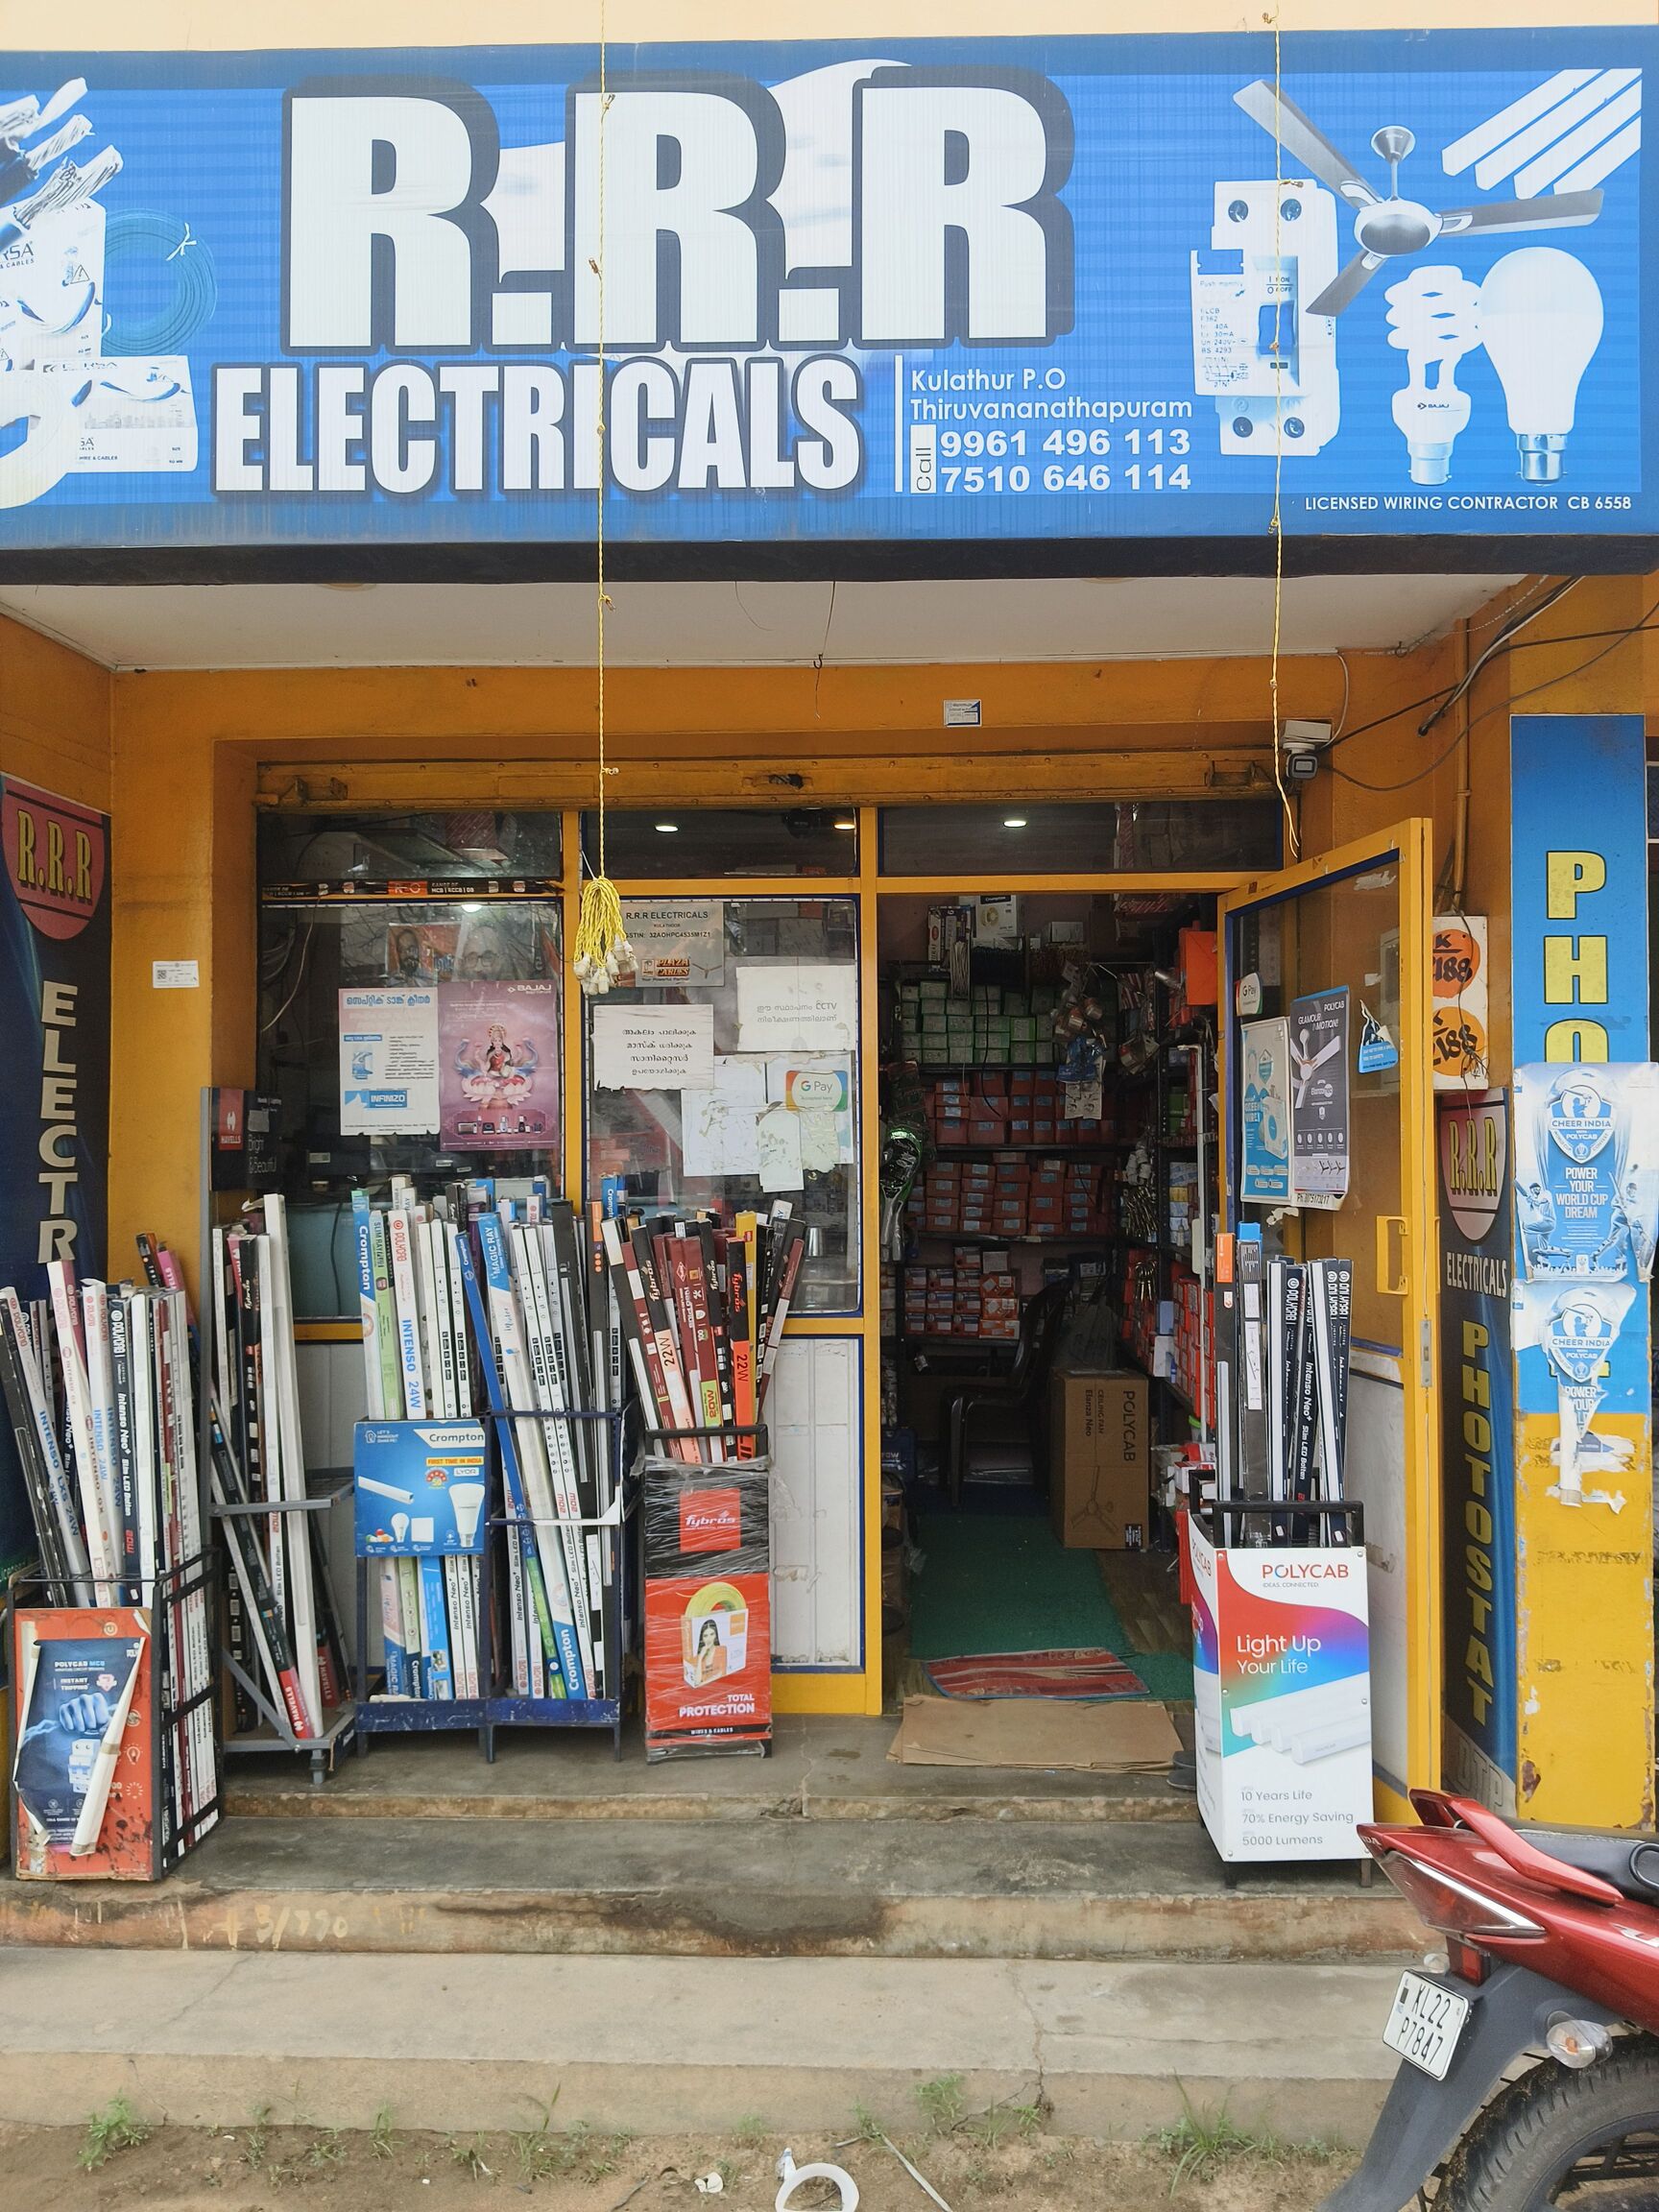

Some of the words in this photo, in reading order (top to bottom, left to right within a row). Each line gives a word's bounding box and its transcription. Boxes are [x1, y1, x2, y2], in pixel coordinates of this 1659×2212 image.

[289, 87, 1047, 349] R.R.R
[911, 368, 1015, 392] Kulathur
[1022, 367, 1067, 391] P.O
[910, 397, 1192, 423] Thiruvananathapuram
[215, 358, 861, 494] ELECTRICALS
[940, 429, 1027, 456] 9961
[1043, 428, 1112, 455] 496
[1123, 427, 1191, 455] 113
[916, 446, 933, 492] Call
[940, 467, 1030, 493] 7510
[1043, 465, 1112, 492] 646
[1123, 465, 1192, 491] 114
[1305, 497, 1379, 511] LICENSED
[1383, 496, 1443, 510] WIRING
[1447, 495, 1559, 510] CONTRACTOR
[1567, 495, 1591, 510] CB
[1594, 495, 1632, 509] 6558
[651, 911, 709, 920] ELECTRICALS
[1323, 999, 1345, 1012] POLYCAB
[813, 1081, 833, 1093] Pay
[1551, 1119, 1582, 1128] CHEER
[1584, 1119, 1612, 1128] INDIA
[1565, 1167, 1598, 1179] POWER
[1570, 1181, 1595, 1192] YOUR
[1555, 1193, 1588, 1206] WORLD
[1590, 1193, 1609, 1206] CUP
[1565, 1206, 1598, 1219] DREAM
[373, 1221, 382, 1238] SLIM
[485, 1227, 495, 1244] RAY
[358, 1225, 373, 1290] Crompton
[395, 1232, 407, 1262] POLYCAB
[1446, 1251, 1507, 1299] ELECTRICALS
[1286, 1288, 1298, 1321] POLYCAB
[111, 1321, 125, 1355] POLYCAB
[401, 1319, 417, 1372] INTENSO
[659, 1336, 676, 1367] 22W
[1551, 1337, 1584, 1346] CHEER
[1585, 1338, 1611, 1348] INDIA
[736, 1354, 749, 1382] 22W
[1304, 1361, 1314, 1395] Intenso
[407, 1381, 421, 1409] 24W
[706, 1388, 717, 1419] 20W
[117, 1393, 129, 1429] Intenso
[93, 1409, 105, 1452] INTENSO
[429, 1433, 484, 1443] Crompton
[1085, 1418, 1094, 1436] Neo
[1123, 1390, 1137, 1462] POLYCAB
[39, 1410, 60, 1469] INTENSO
[64, 1504, 81, 1537] 24W
[1459, 1318, 1494, 1727] PHOTOSTAT
[1262, 1563, 1350, 1579] POLYCAB
[451, 1600, 460, 1630] Intenso
[463, 1599, 472, 1630] Intenso
[515, 1592, 523, 1622] Intenso
[576, 1599, 586, 1629] Intenso
[1237, 1634, 1287, 1654] Light
[1292, 1634, 1321, 1657] Up
[559, 1628, 580, 1692] Crompton
[1237, 1659, 1277, 1674] Your
[1280, 1659, 1309, 1674] Life
[320, 1667, 332, 1700] HAVELLS
[284, 1686, 300, 1720] HAVELLS
[679, 1702, 756, 1718] PROTECTION
[727, 1694, 755, 1702] TOTAL
[1240, 1791, 1254, 1801] 10
[1256, 1790, 1290, 1801] Years
[1292, 1790, 1313, 1801] Life
[1242, 1812, 1265, 1824] 70%
[1268, 1812, 1310, 1827] Energy
[1312, 1811, 1354, 1827] Saving
[1242, 1835, 1273, 1845] 5000
[1276, 1834, 1323, 1845] Lumens
[1411, 1984, 1452, 2030] KL22
[1397, 2016, 1445, 2066] P7847
